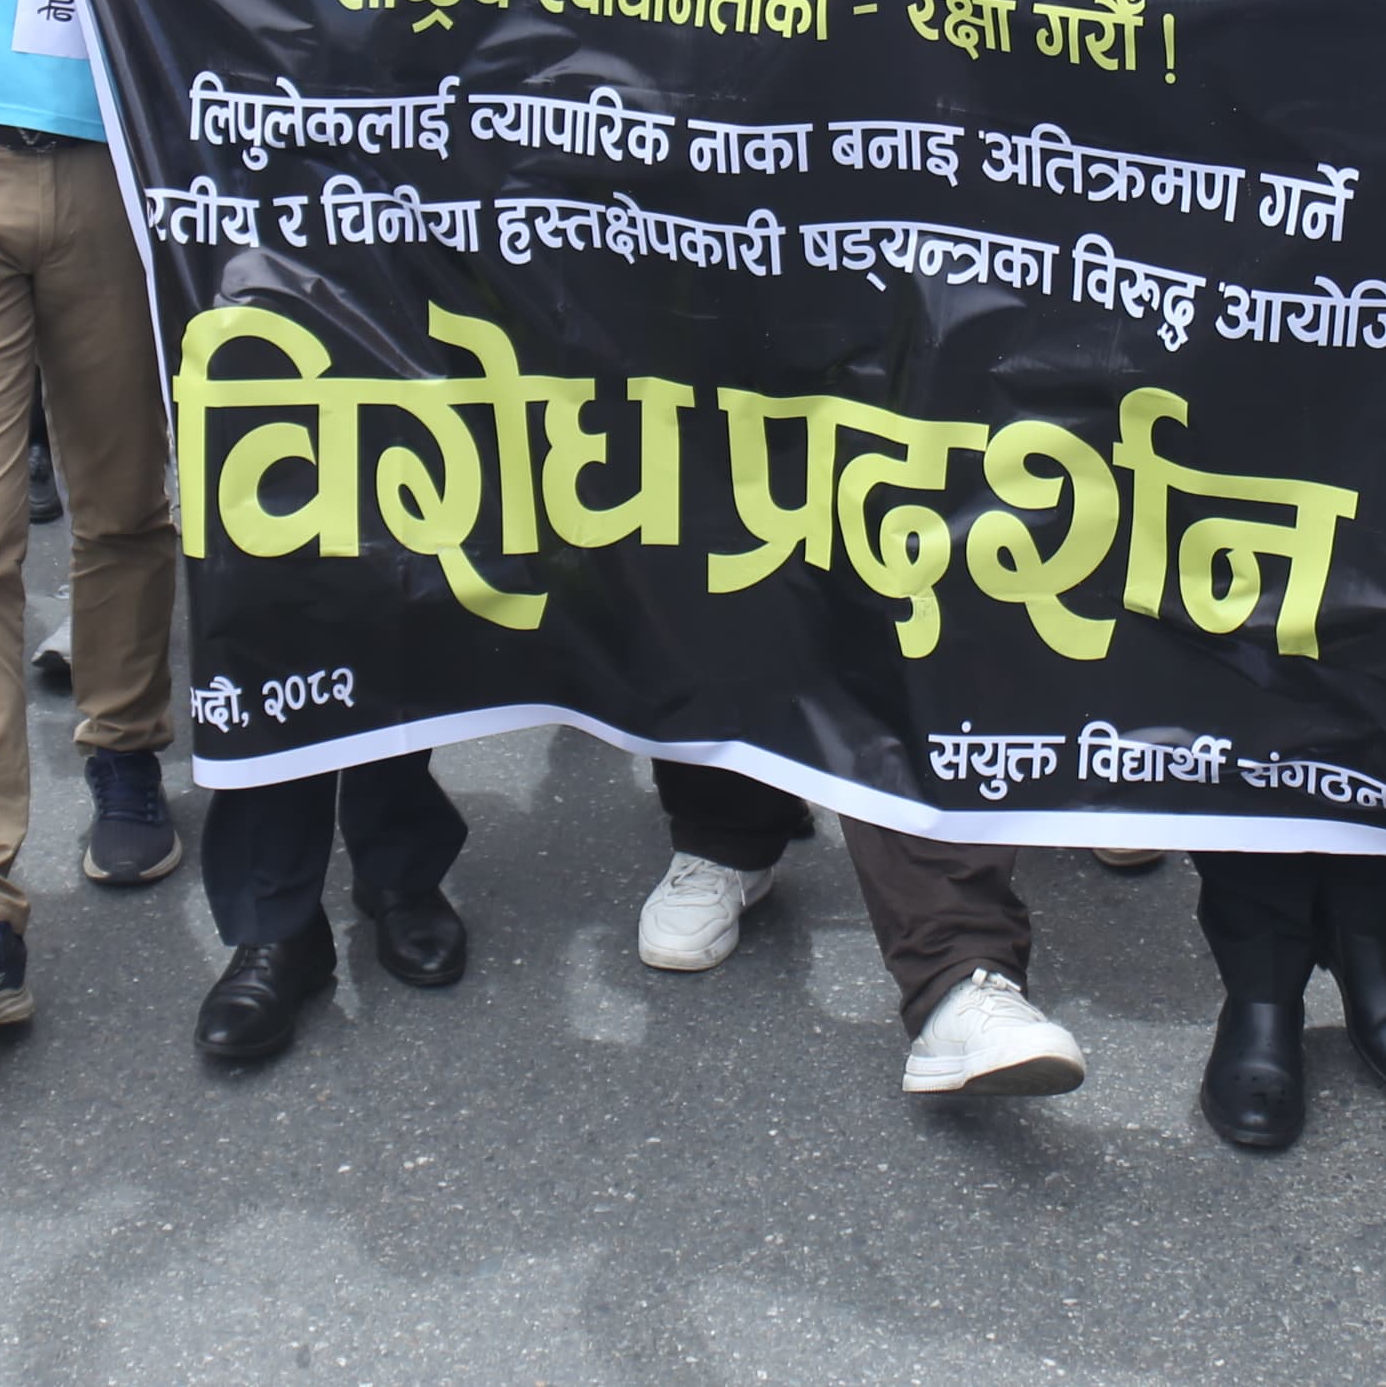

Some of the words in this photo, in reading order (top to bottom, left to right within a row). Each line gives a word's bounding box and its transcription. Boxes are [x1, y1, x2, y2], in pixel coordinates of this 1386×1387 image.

[1163, 13, 1177, 84] !
[189, 70, 460, 171] लिपुलेकलाई
[469, 87, 675, 165] व्यापारिक
[688, 119, 812, 174] नाका
[828, 121, 964, 187] बनाइ
[978, 123, 1245, 222] अतिक्रमण
[1259, 162, 1359, 241] गर्ने
[144, 175, 259, 247] रतीय
[273, 195, 308, 248] र
[321, 175, 481, 252] चिनीया
[494, 192, 786, 276] हस्तक्षेपकारी
[799, 221, 1060, 295] षड्यन्त्रका
[172, 299, 695, 631] विरोध
[708, 386, 1358, 660] प्रदर्शन
[262, 667, 355, 723] २०८२
[928, 720, 1066, 800] संयुक्त
[1077, 721, 1232, 784] विद्यार्थी
